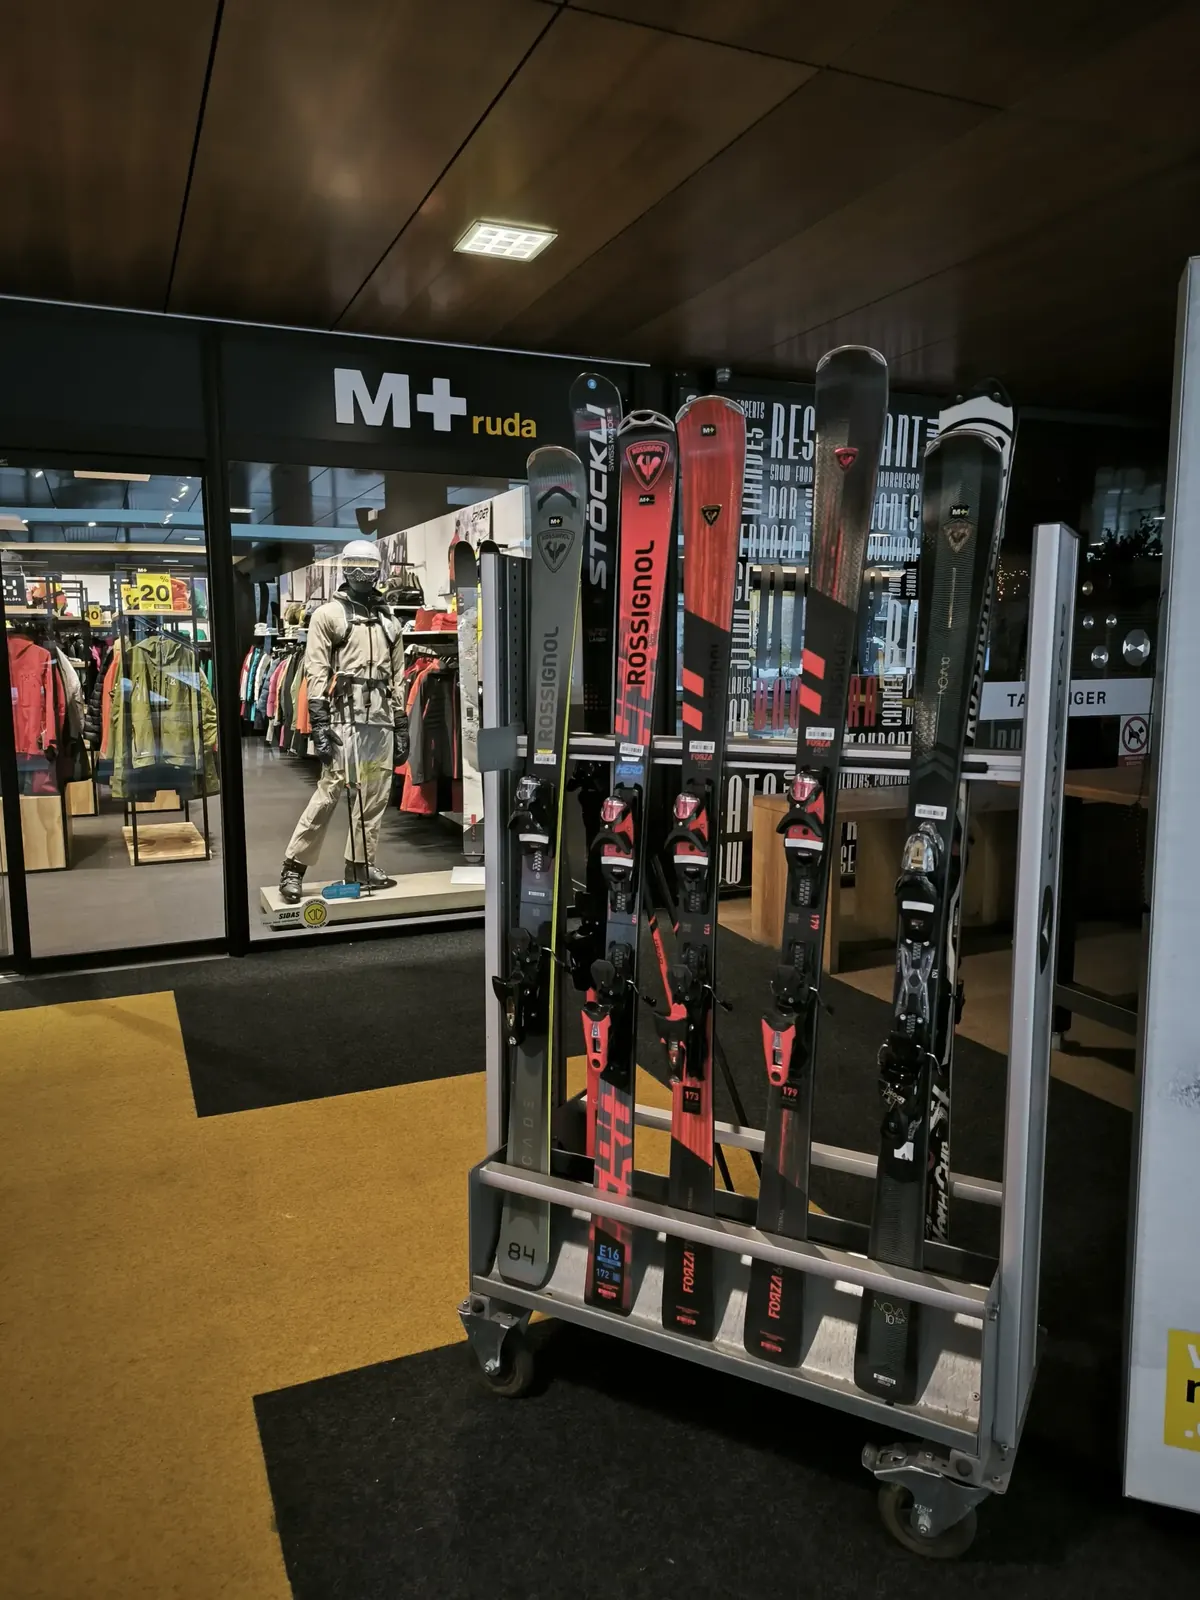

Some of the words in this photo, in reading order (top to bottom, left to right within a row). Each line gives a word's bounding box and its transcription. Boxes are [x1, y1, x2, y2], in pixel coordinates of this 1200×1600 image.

[334, 367, 466, 431] M+
[472, 413, 537, 439] ruda
[608, 444, 616, 471] SWISS
[586, 403, 607, 590] STÖCKLI
[768, 486, 798, 520] BAR
[739, 523, 797, 559] ERRAZA
[140, 584, 170, 602] 20
[627, 540, 655, 686] ROSSIGNOL
[537, 626, 559, 745] ROSSIGNOL
[278, 911, 300, 920] SIDAS
[685, 1091, 700, 1101] 173
[782, 1086, 798, 1097] 179
[508, 1242, 536, 1266] 84
[599, 1244, 620, 1261] E16
[596, 1268, 609, 1279] 172
